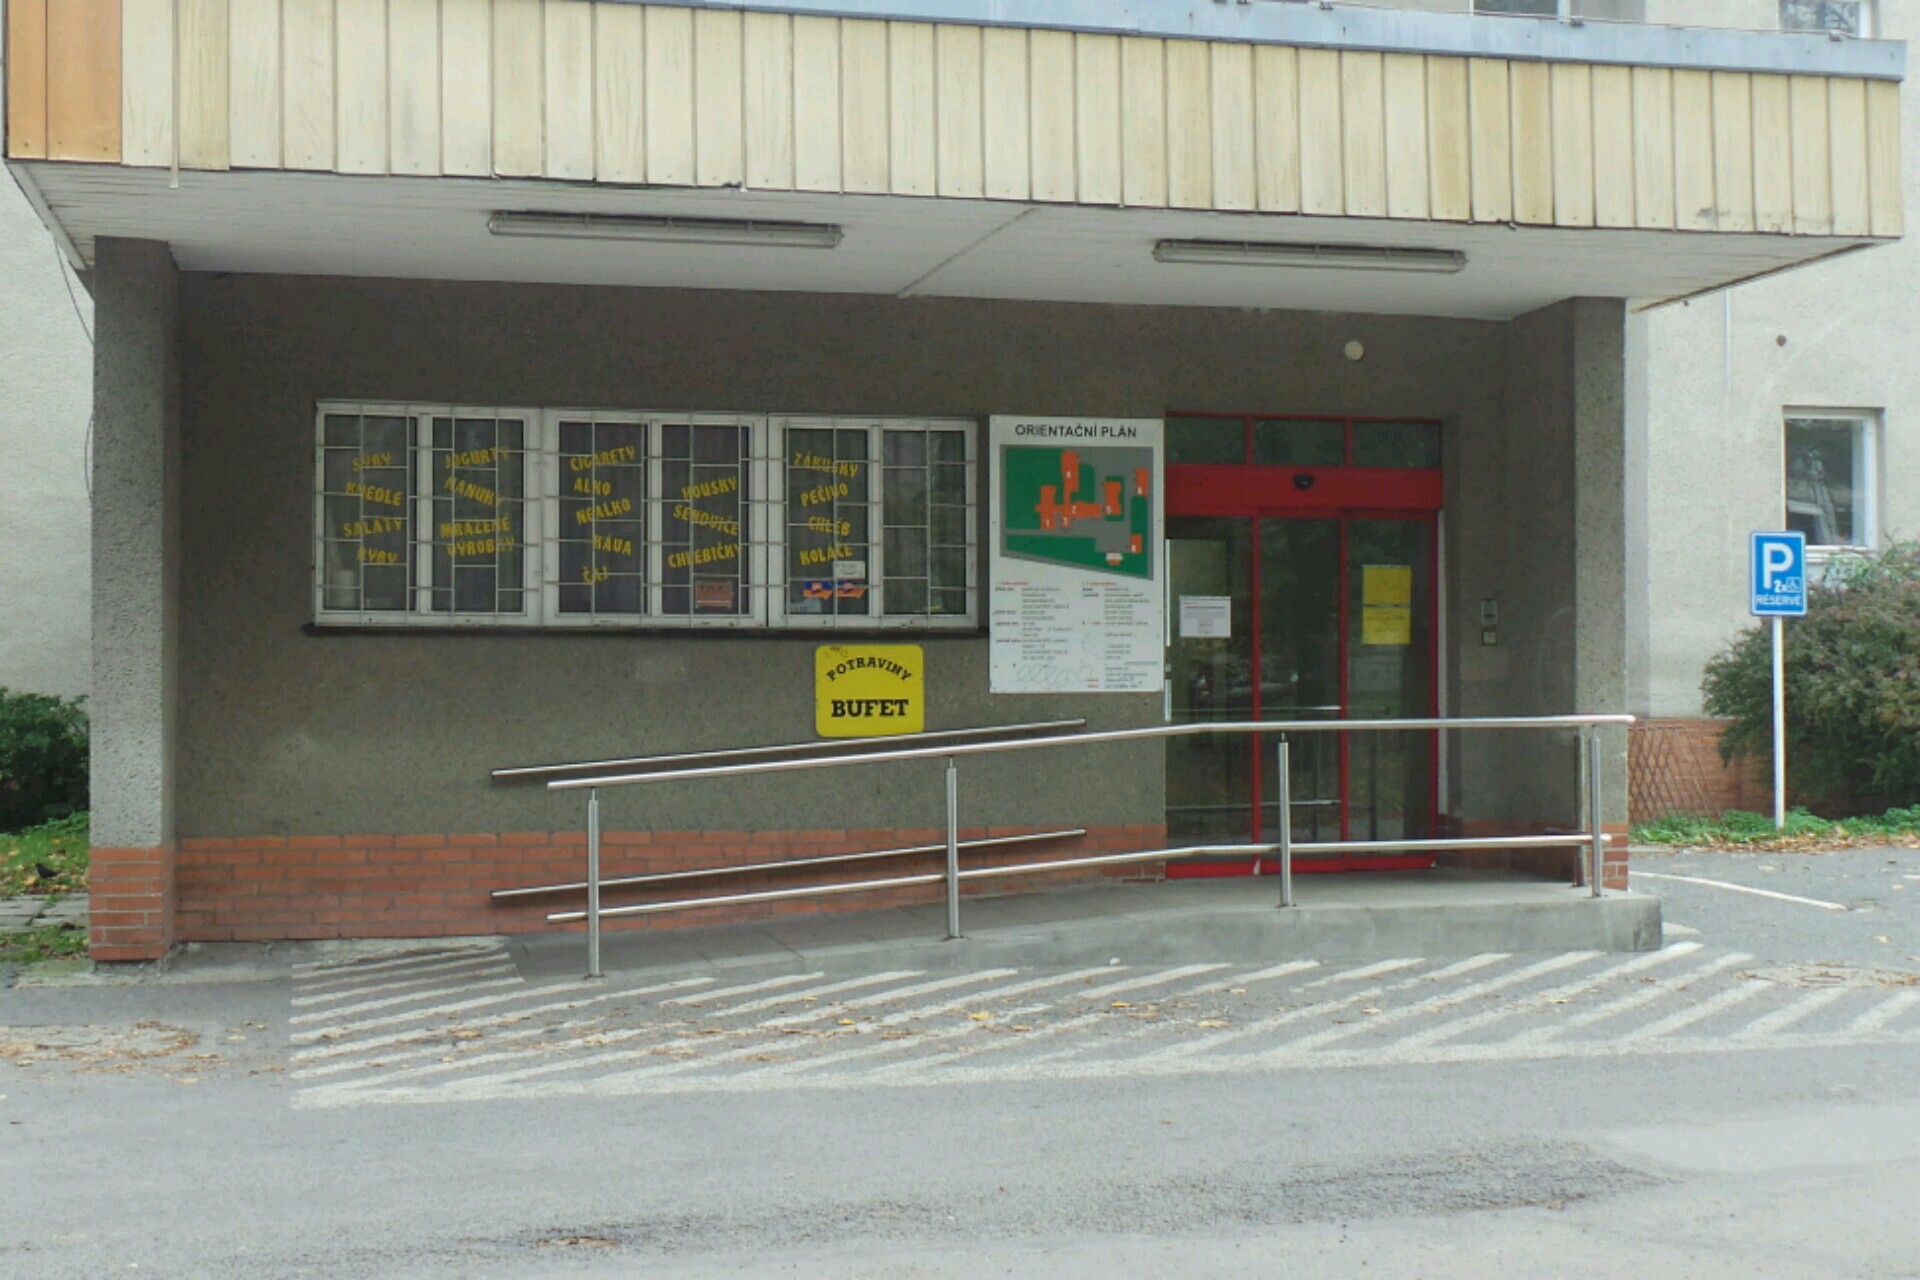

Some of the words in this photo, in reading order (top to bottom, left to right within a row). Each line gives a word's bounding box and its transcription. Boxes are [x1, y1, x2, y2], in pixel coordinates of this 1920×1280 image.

[1015, 423, 1097, 438] ORIENTAČNÍ
[1101, 426, 1137, 438] PLÁN
[570, 446, 636, 472] CIGARETY
[573, 477, 612, 497] ALKO
[681, 476, 737, 502] HOUSKY
[576, 498, 632, 525] NEALKO
[1763, 542, 1794, 589] P
[826, 657, 912, 682] POTRAVINY
[831, 699, 909, 718] BUFET
